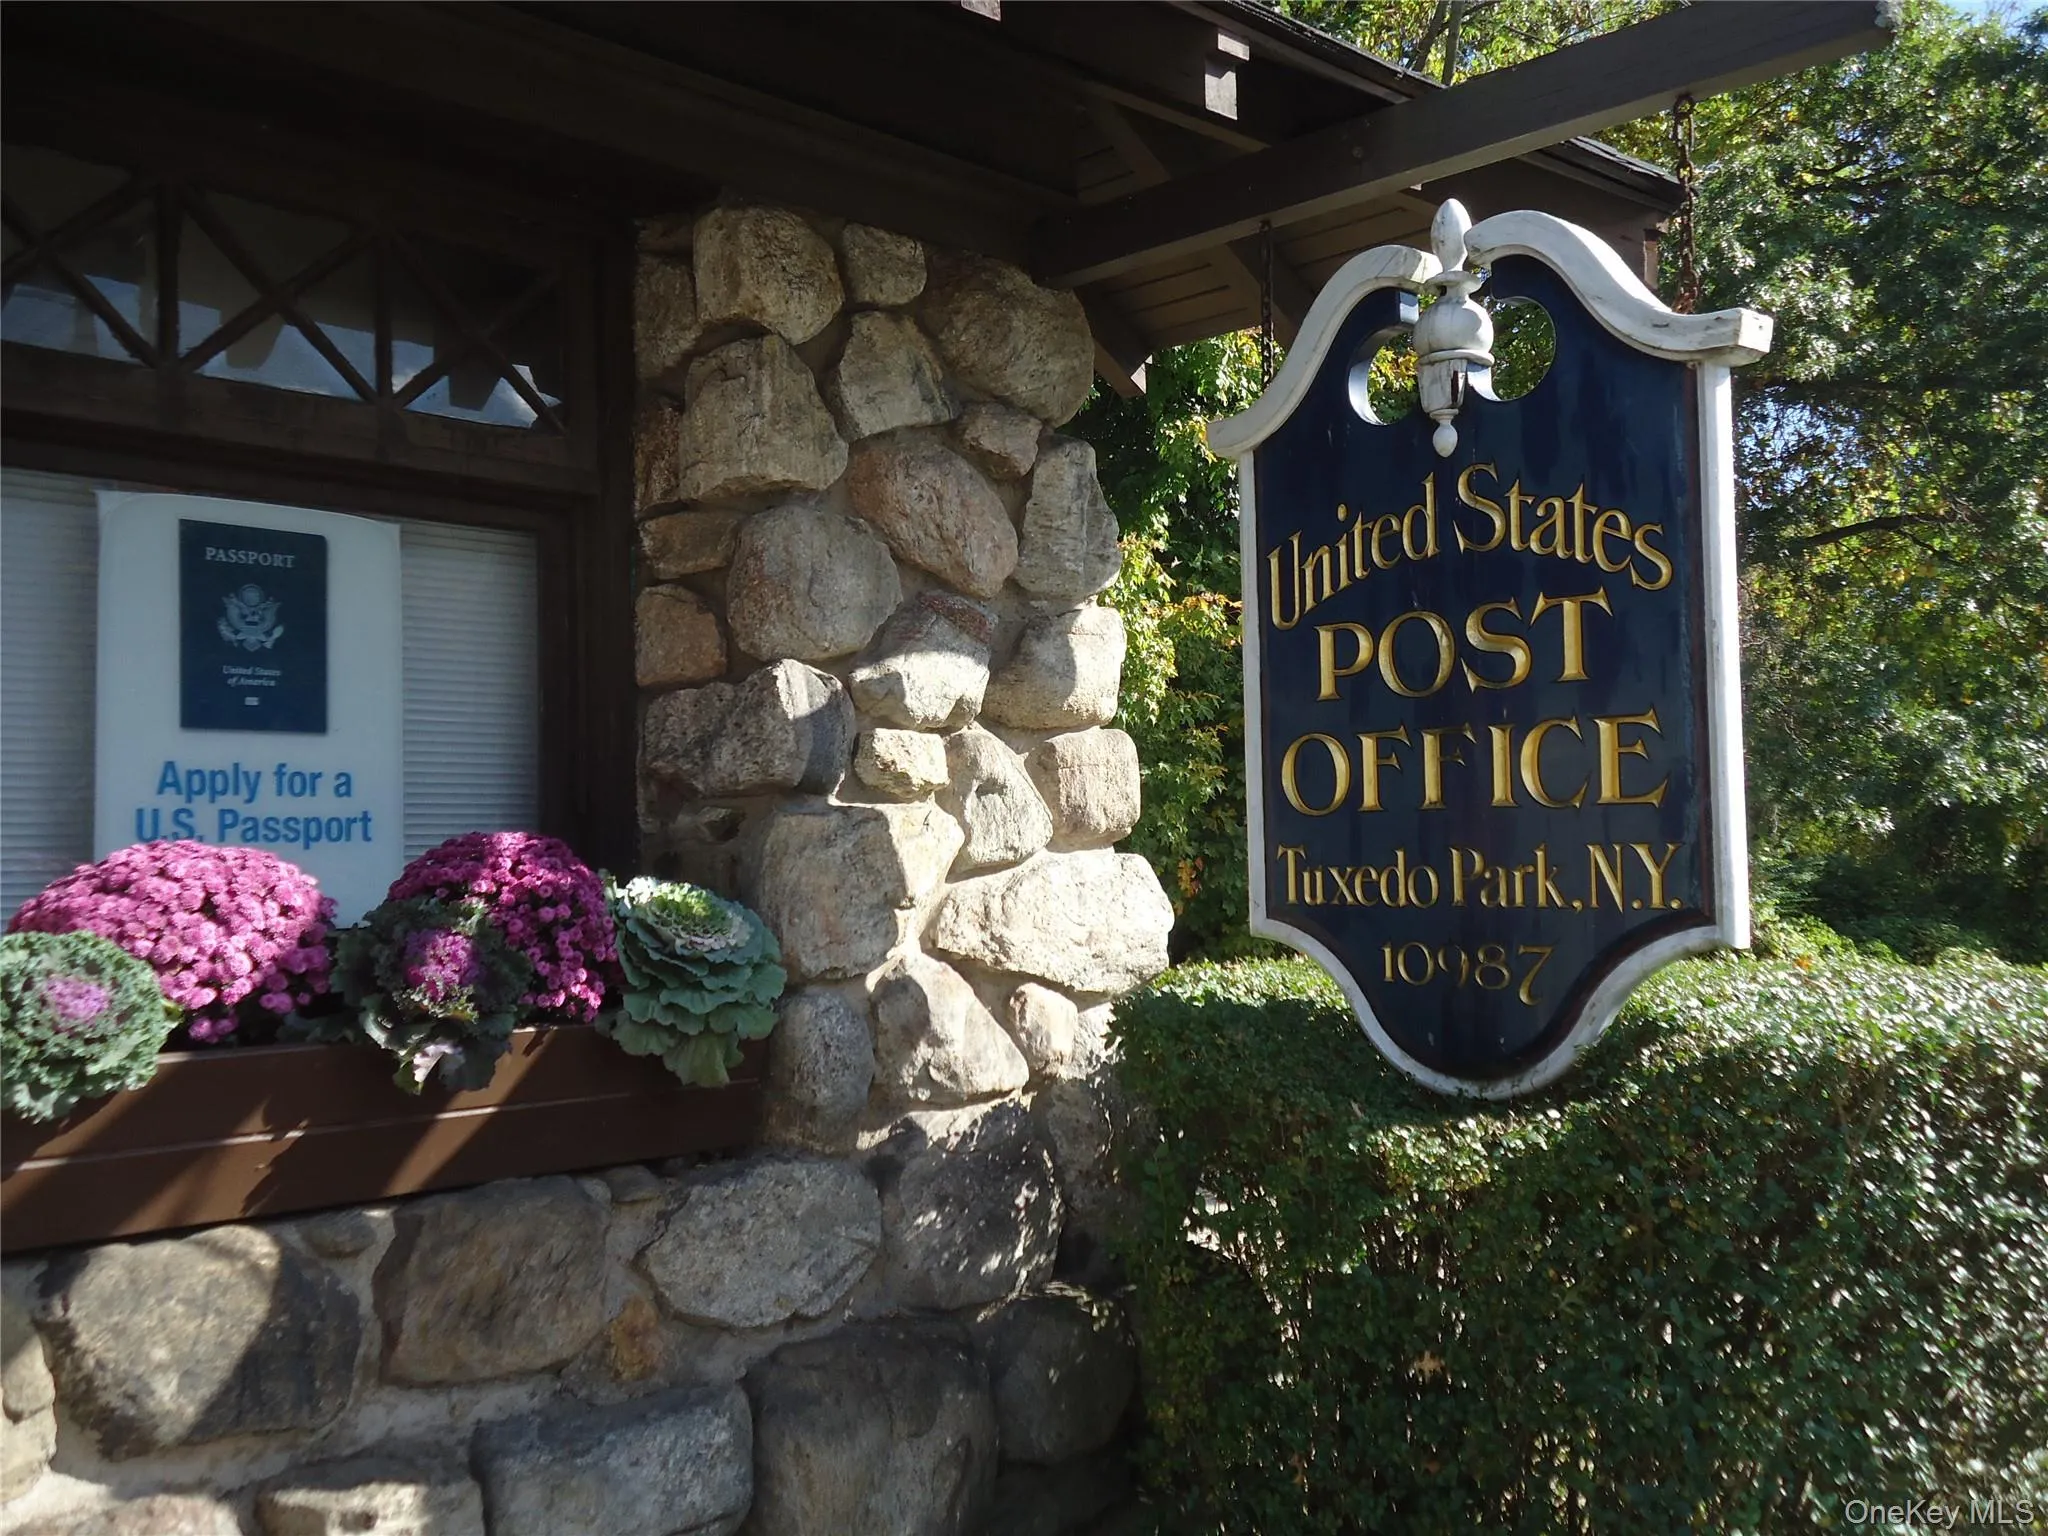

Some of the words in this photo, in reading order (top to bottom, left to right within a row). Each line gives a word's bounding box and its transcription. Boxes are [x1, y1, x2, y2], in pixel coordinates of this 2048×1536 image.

[205, 546, 295, 568] PASSPORT
[1267, 472, 1440, 631] United
[1453, 463, 1674, 592] States
[222, 665, 252, 675] United
[254, 666, 281, 676] States
[1314, 586, 1614, 700] POST
[227, 676, 239, 687] of
[240, 677, 276, 687] America
[157, 760, 262, 804] Apply
[272, 763, 323, 797] for
[333, 771, 352, 798] a
[1281, 706, 1669, 816] OFFICE
[135, 808, 204, 843] U.S.
[217, 808, 372, 849] Passport
[1276, 843, 1440, 909] Tuxedo
[1449, 842, 1583, 912] Park,
[1587, 843, 1683, 915] N.Y.
[1381, 941, 1556, 1007] 10987
